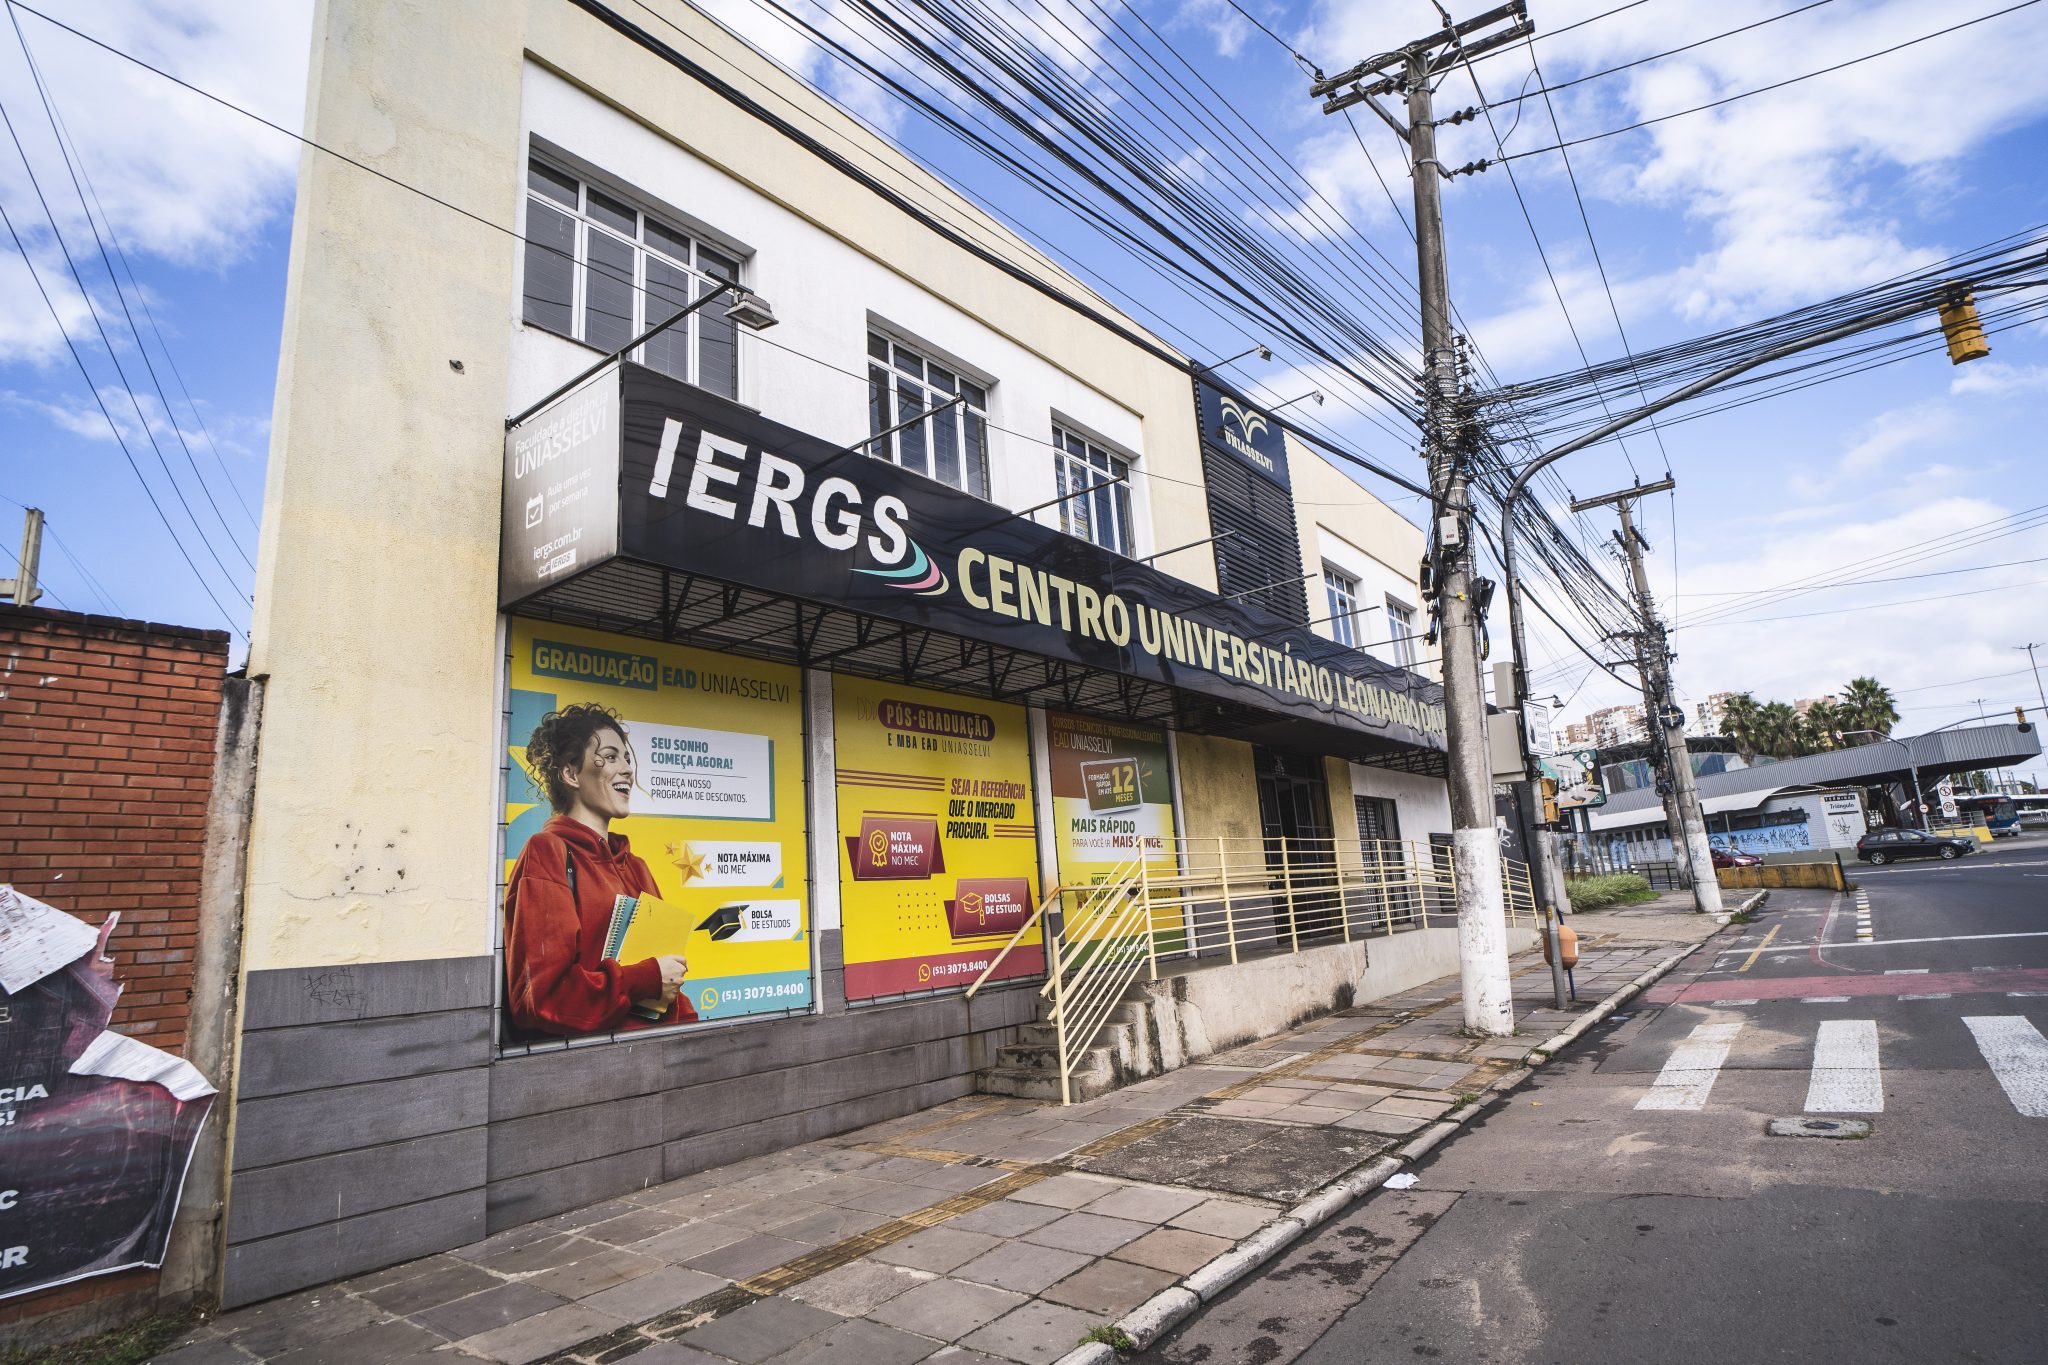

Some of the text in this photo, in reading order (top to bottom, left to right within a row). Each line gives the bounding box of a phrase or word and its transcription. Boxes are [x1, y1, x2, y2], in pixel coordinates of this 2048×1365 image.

[514, 406, 607, 479] UNIASSELVI
[515, 420, 559, 456] Faculdade
[1224, 430, 1274, 473] UNIASSELVI
[547, 482, 562, 497] Aula
[564, 474, 579, 489] uma
[648, 417, 909, 564] IERGS
[549, 486, 588, 517] por semana
[533, 527, 583, 560] iergs.com.br
[957, 547, 1131, 647] CENTRO
[1136, 604, 1334, 705] UNIVERSITÁRIO
[1335, 673, 1421, 729] LEONARDO
[535, 646, 790, 704] GRADUAÇÃO EAD UNIASSELVI
[886, 703, 989, 739] PÓS-GRADUAÇÃO
[651, 736, 709, 753] SEU SONHO
[887, 733, 991, 758] E MBA EAD UNIASSELVI
[1053, 730, 1113, 754] EAD UNIASSELVI
[651, 752, 733, 770] COMEÇA AGORA!
[650, 776, 712, 791] CONHEÇA NOSSO
[1088, 772, 1110, 781] FORMAÇÃO
[1096, 780, 1111, 788] RÁPIDA
[1112, 765, 1134, 794] 12
[651, 789, 748, 803] PROGRAMA DE DESCONTOS.
[950, 778, 1026, 800] SEJA A REFERÊNCIA
[1115, 793, 1133, 803] MESES
[948, 799, 1015, 820] QUE O MERCADO
[945, 822, 990, 840] PROCURA.
[1071, 817, 1136, 833] MAIS RÁPIDO
[890, 831, 912, 842] NOTA
[1072, 836, 1163, 848] PARA VOCÊ IR MAIS LNGE.
[891, 841, 923, 854] MÁXIMA
[717, 851, 771, 863] NOTA MÁXIMA
[891, 855, 919, 866] NO MEC
[717, 864, 747, 875] NO MEC
[984, 893, 1011, 903] BOLSAS
[751, 910, 773, 919] BOLSA
[985, 903, 1022, 915] DE ESTUDO
[751, 919, 791, 930] DE ESTUDOS
[932, 960, 988, 976] (51) 3079.8400
[722, 982, 804, 1001] (51) 3079.8400
